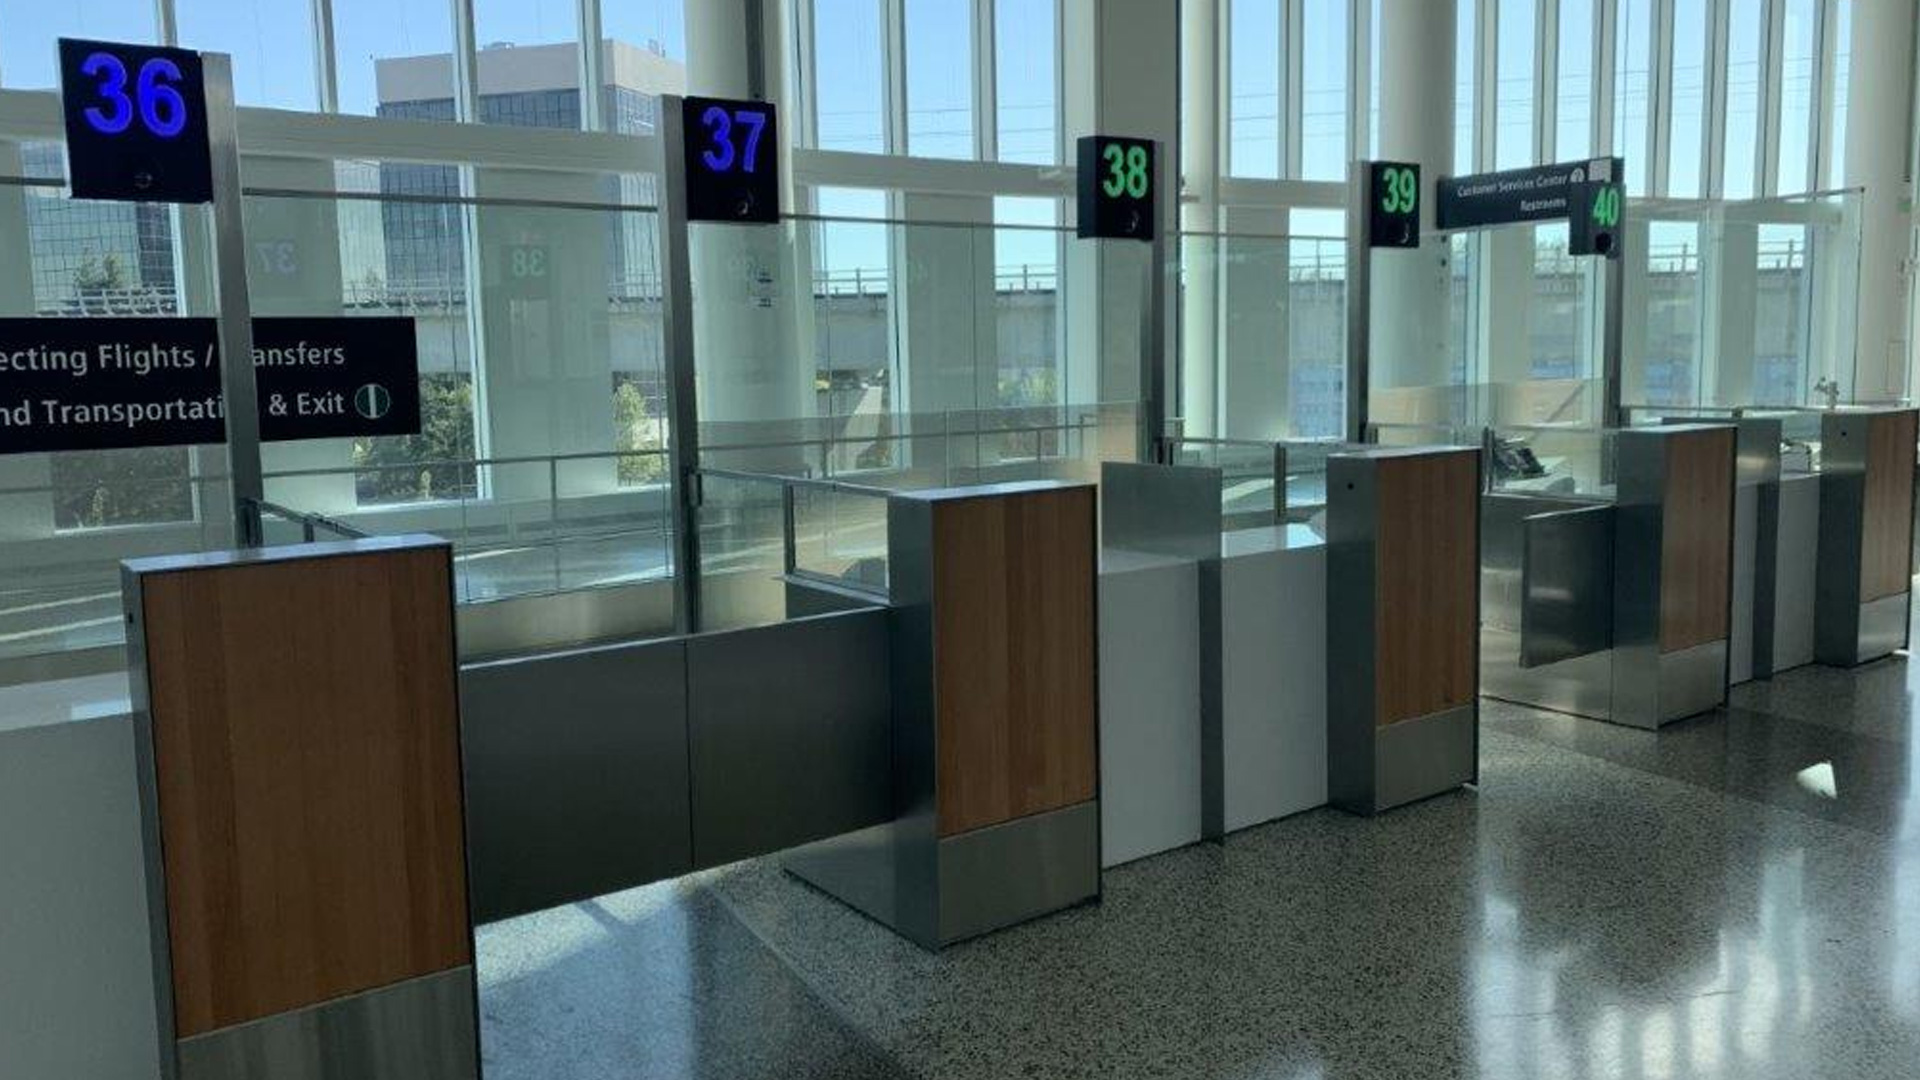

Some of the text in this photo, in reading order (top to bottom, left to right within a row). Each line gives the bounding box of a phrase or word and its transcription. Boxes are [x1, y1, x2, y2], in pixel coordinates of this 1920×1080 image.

[82, 52, 187, 138] 36
[703, 106, 766, 173] 37
[1103, 144, 1148, 199] 38
[1382, 168, 1416, 213] 39
[1499, 178, 1535, 193] Services
[1536, 174, 1568, 188] Center
[1593, 187, 1620, 227] 40
[98, 342, 196, 375] Flights
[252, 341, 345, 366] ansfers
[41, 395, 224, 428] Transportati
[269, 393, 288, 416] &
[297, 391, 345, 415] Exit
